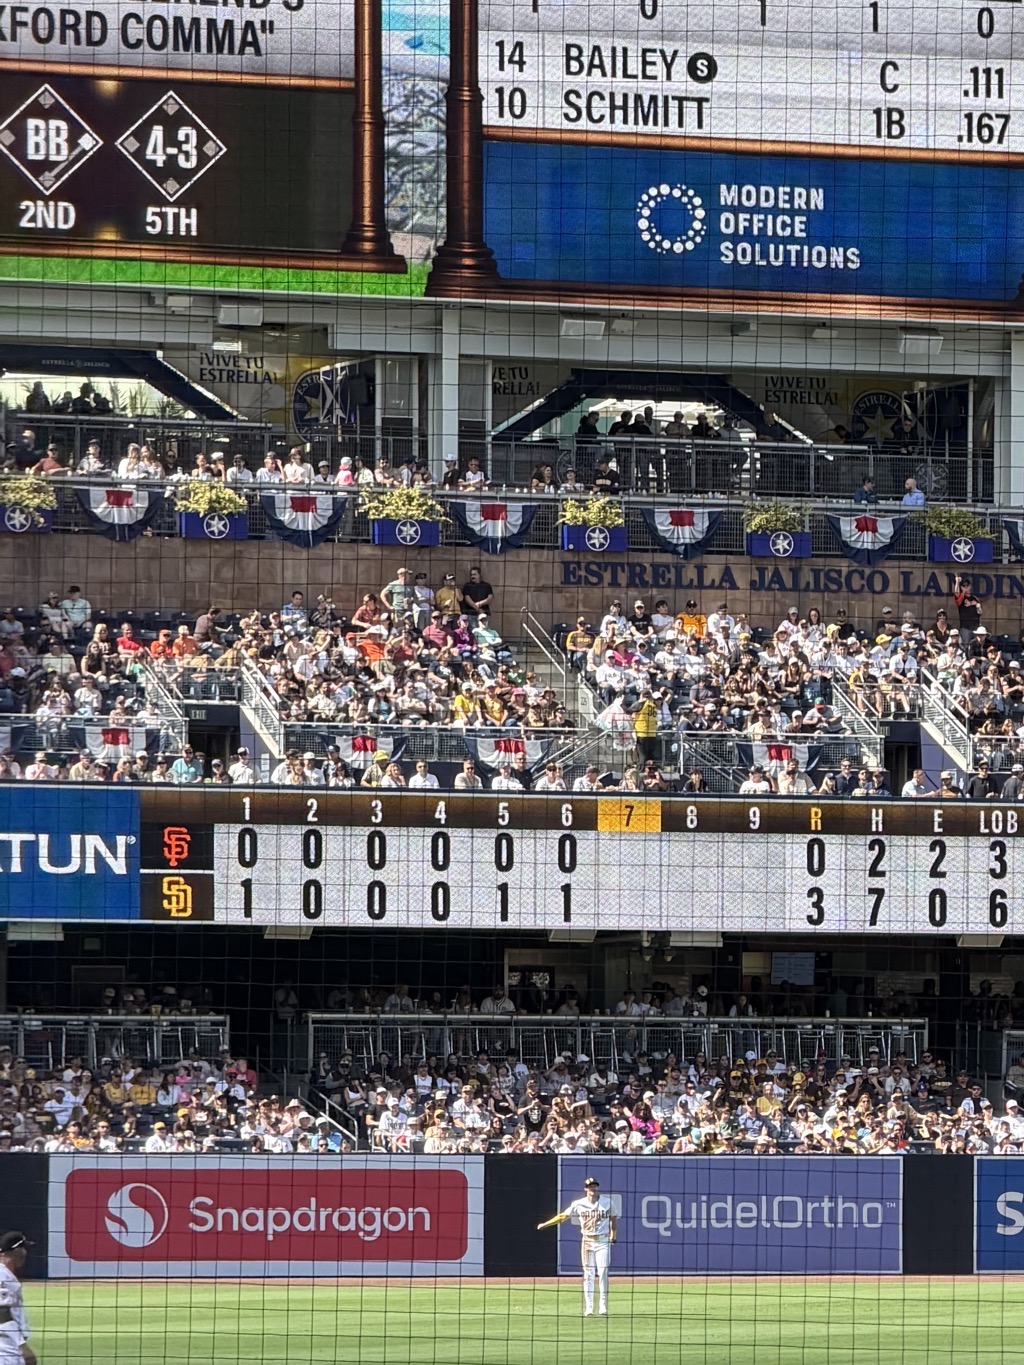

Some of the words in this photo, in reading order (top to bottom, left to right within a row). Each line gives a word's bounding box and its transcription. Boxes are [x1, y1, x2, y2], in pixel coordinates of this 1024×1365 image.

[121, 12, 274, 57] COMMA"
[869, 1, 878, 32] 1
[977, 8, 994, 38] 0
[496, 41, 526, 73] 14
[565, 43, 676, 82] BAILEY
[879, 60, 900, 94] C
[962, 66, 1005, 100] .111
[495, 87, 527, 120] 10
[563, 90, 710, 130] SCHMITT
[872, 107, 905, 141] 1B
[957, 111, 1011, 145] .167
[26, 118, 69, 162] BB
[145, 124, 198, 170] 4-3
[19, 201, 75, 229] 2ND
[720, 184, 824, 211] MODERN
[145, 206, 197, 236] 5TH
[720, 213, 807, 238] OFFICE
[720, 243, 861, 270] SOLUTIONS
[244, 357, 264, 369] TU
[510, 367, 528, 380] TU
[493, 382, 540, 395] RELLA!
[806, 377, 826, 389] TU
[561, 560, 738, 589] ESTRELLA
[750, 566, 890, 594] JALISCO
[243, 797, 250, 820] 1
[307, 799, 318, 821] 2
[371, 800, 383, 823] 3
[435, 801, 446, 825] 4
[498, 802, 509, 826] 5
[562, 803, 573, 827] 6
[624, 805, 634, 827] 7
[687, 806, 697, 829] 8
[749, 807, 760, 830] 9
[811, 808, 821, 831] R
[872, 809, 883, 832] H
[934, 810, 943, 832] E
[979, 810, 1018, 834] LOB
[0, 833, 127, 875] TUN
[238, 827, 257, 868] 0
[303, 829, 323, 869] 0
[367, 830, 387, 870] 0
[431, 831, 450, 871] 0
[495, 832, 514, 873] 0
[558, 833, 577, 874] 0
[807, 837, 825, 878] 0
[868, 838, 886, 878] 2
[929, 839, 947, 879] 2
[989, 840, 1007, 879] 3
[240, 877, 252, 918] 1
[303, 879, 323, 919] 0
[367, 880, 387, 920] 0
[431, 881, 450, 921] 0
[498, 882, 508, 922] 1
[561, 883, 571, 923] 1
[807, 887, 824, 926] 3
[868, 888, 885, 927] 7
[929, 889, 947, 928] 0
[989, 889, 1007, 928] 6
[189, 1196, 431, 1241] Snapdragon
[641, 1195, 884, 1236] QuidelOrtho
